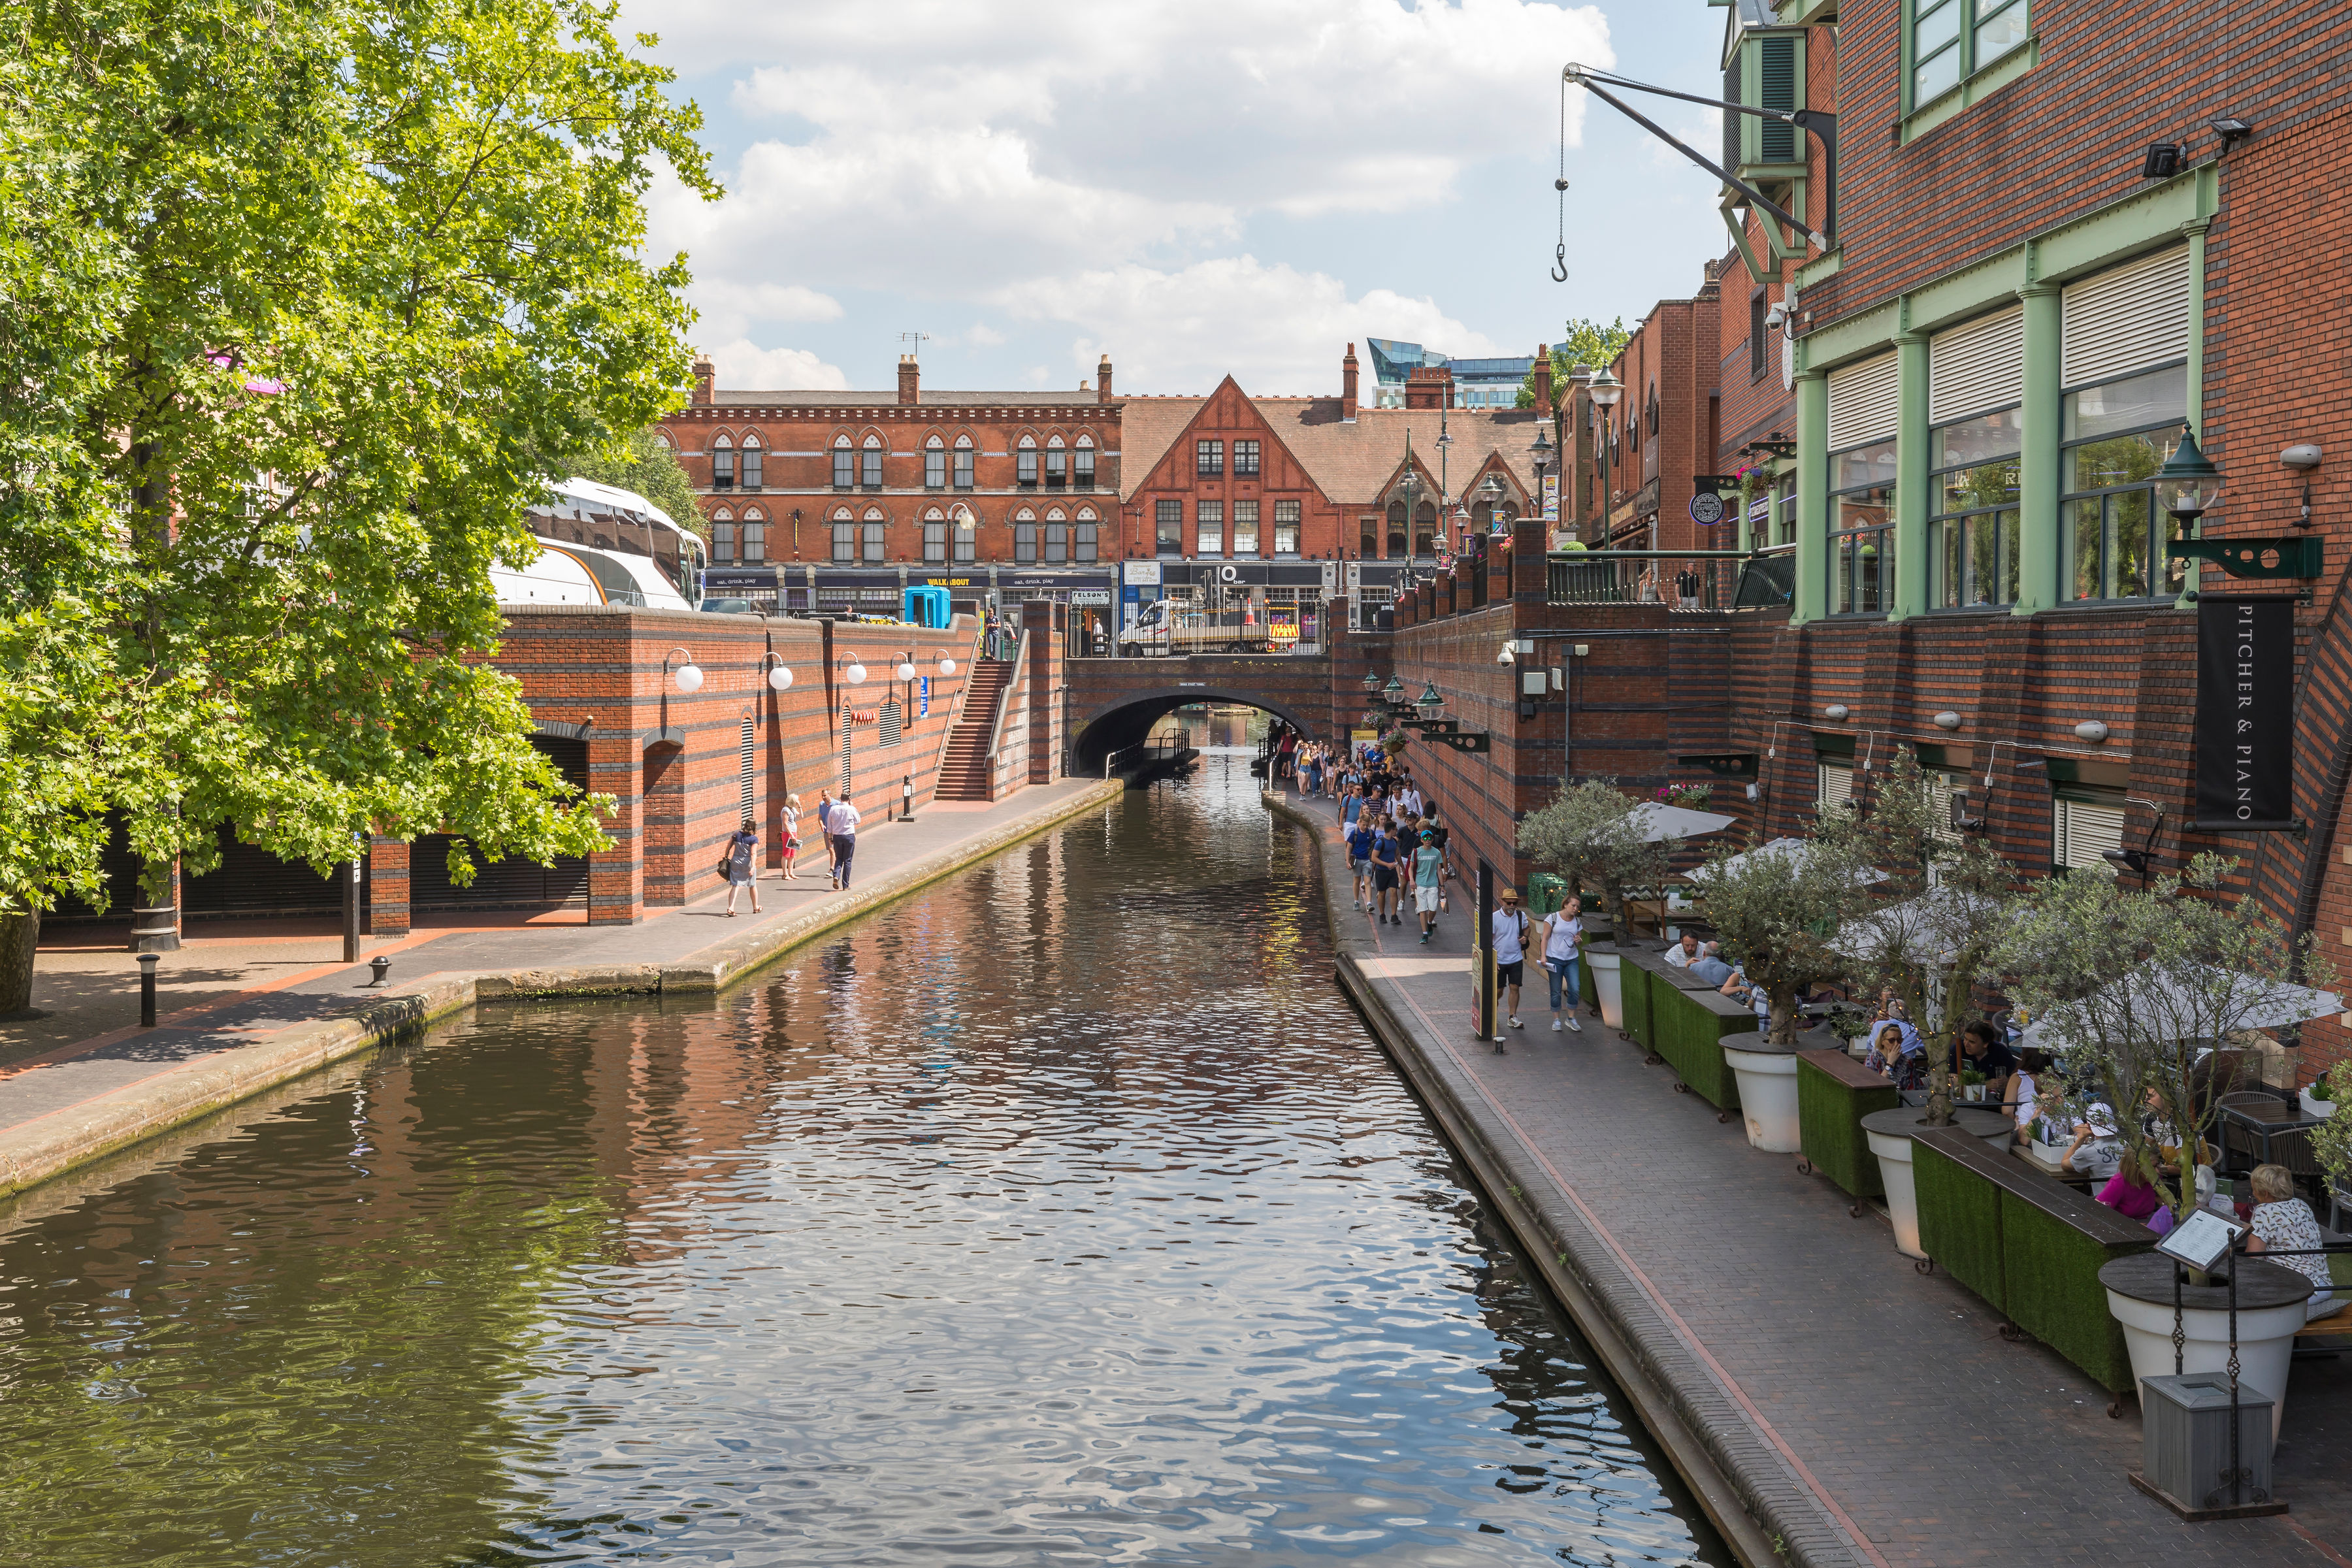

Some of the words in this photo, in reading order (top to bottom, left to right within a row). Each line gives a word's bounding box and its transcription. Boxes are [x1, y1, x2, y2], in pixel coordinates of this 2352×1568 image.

[1222, 566, 1237, 581] O
[2238, 605, 2253, 710] PITCHER
[2238, 719, 2252, 734] &
[2237, 745, 2252, 820] PIANO
